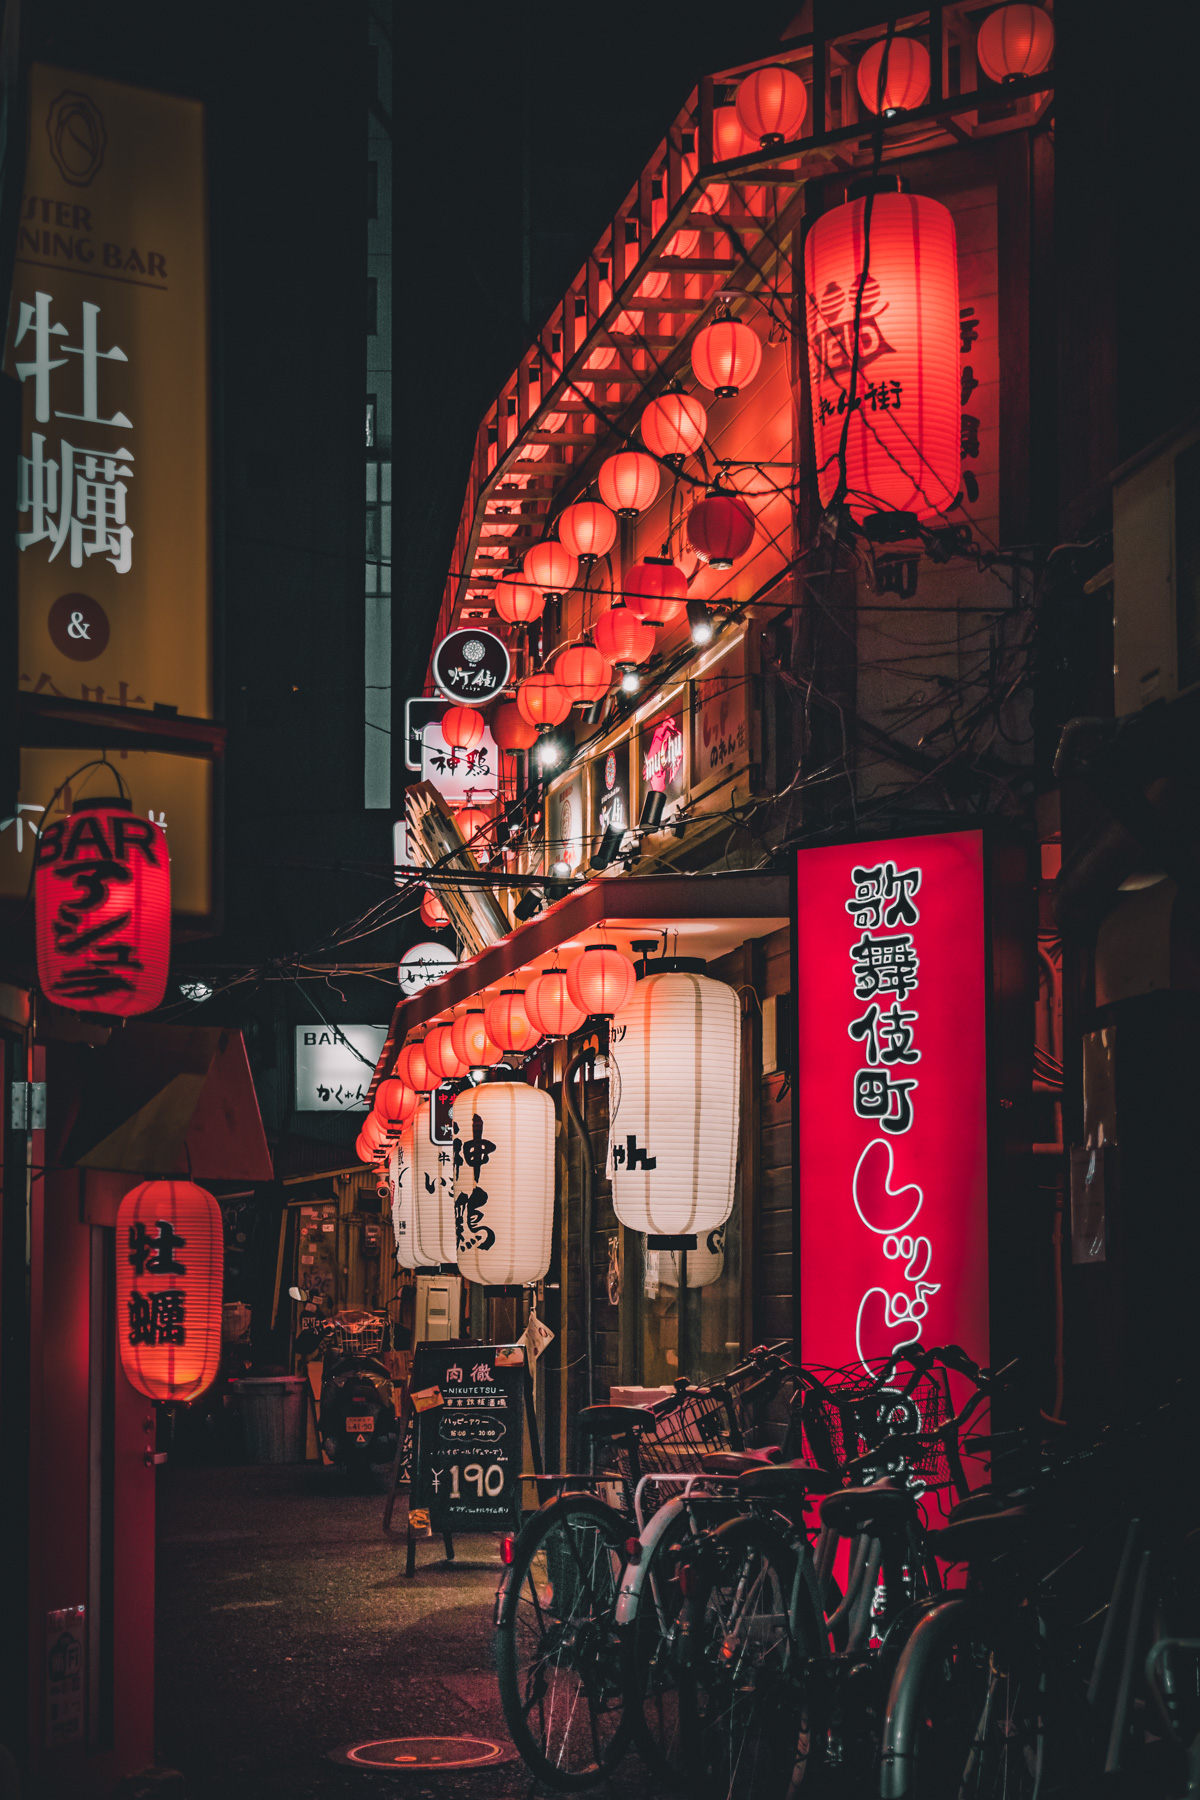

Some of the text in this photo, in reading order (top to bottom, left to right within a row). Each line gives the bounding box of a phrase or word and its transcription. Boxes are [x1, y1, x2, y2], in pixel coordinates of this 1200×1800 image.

[102, 242, 167, 279] BAR
[37, 816, 160, 869] BAR
[304, 1032, 346, 1046] BAR
[444, 1417, 489, 1426] ハッピーアワー
